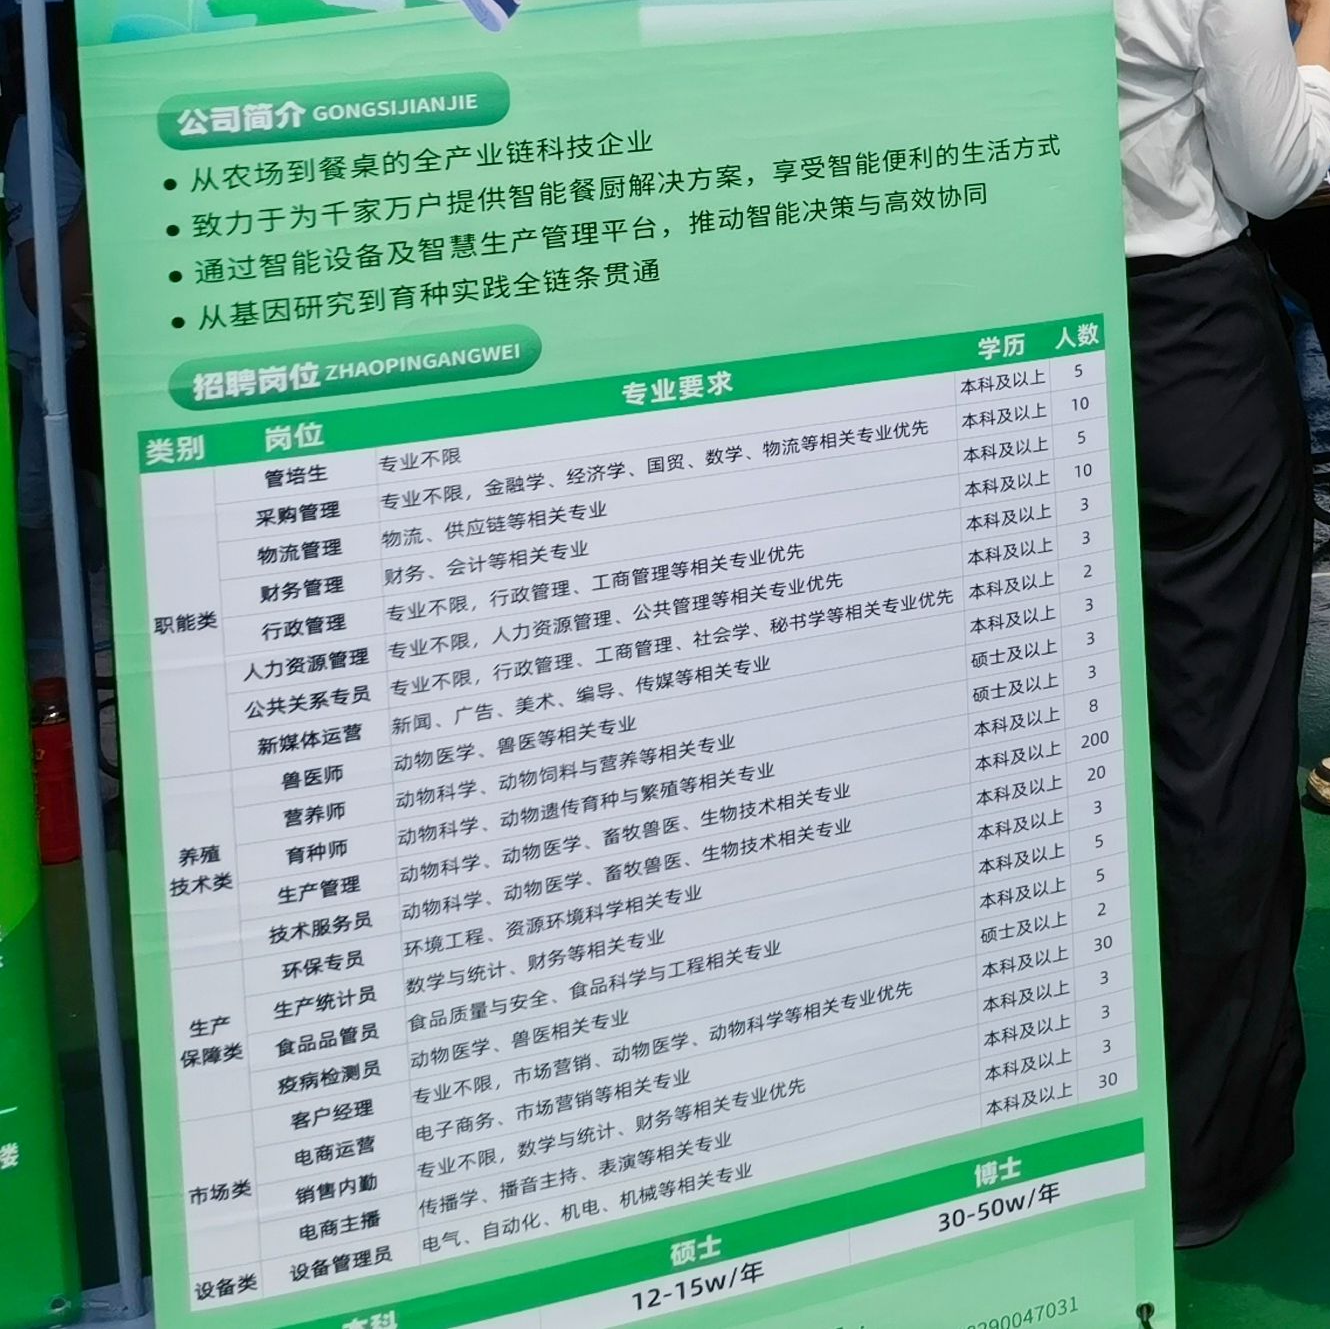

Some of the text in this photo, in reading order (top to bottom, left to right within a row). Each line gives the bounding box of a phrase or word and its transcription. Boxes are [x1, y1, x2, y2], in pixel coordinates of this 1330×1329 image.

[177, 93, 478, 137] 公司简介 GONGSIJIANJIE
[191, 129, 653, 192] 从农场到餐桌的全产业链科技企业
[192, 134, 1062, 238] 致力于为千家万户提供智能餐厨解决方案，享受智能便利的生活方式
[194, 182, 988, 284] 通过智能设备及智慧生产管理平台，推动智能决策与高效协同
[198, 258, 660, 331] 从基因研究到育种实践全链条贯通
[146, 323, 1099, 465] 类别 岗位 专业要求 学历 人数
[193, 344, 521, 401] 招聘岗位 ZHAOPINGANGWEI
[264, 363, 1083, 490] 管培生 专业不限 本科及以上 5
[255, 499, 342, 528] 采购管理
[961, 402, 1048, 430] 本科及以上
[1071, 396, 1090, 412] 10
[256, 430, 1086, 566] 物流管理 物流、供应链等相关专业 本科及以上 5
[259, 462, 1093, 604] 财务管理 财务、会计等相关专业 本科及以上 10
[153, 610, 219, 636] 职能类
[242, 530, 1091, 683] 人力资源管理 专业不限，人力资源管理、公共管理等相关专业优先 本科及以上 3
[261, 497, 1089, 642] 行政管理 专业不限，行政管理、工商管理等相关专业优先 本科及以上 3
[243, 684, 372, 720] 公共关系专员
[968, 570, 1055, 601] 本科及以上
[1083, 564, 1093, 579] 2
[257, 597, 1094, 757] 新媒体运营 新闻、广告、美术、编导、传媒等相关专业 本科及以上 3
[280, 630, 1096, 792] 兽医师 动物医学、兽医等相关专业 硕士及以上 3
[277, 729, 1110, 906] 生产管理 动物科学、动物医学、畜牧兽医、生物技术相关专业 本科及以上 200
[282, 664, 1097, 829] 营养师 动物科学、动物饲料与营养等相关专业 硕士及以上 3
[284, 698, 1099, 866] 育种师 动物科学、动物遗传育种与繁殖等相关专业 本科及以上 8
[169, 871, 234, 898] 技术类
[178, 843, 222, 868] 养殖
[267, 765, 1106, 946] 技术服务员 动物科学、动物医学、畜牧兽医、生物技术相关专业 本科及以上 20
[273, 833, 1104, 1020] 生产统计员 数学与统计、财务等相关专业 本科及以上 5
[281, 799, 1103, 980] 环保专员 环境工程、资源环境科学相关专业 本科及以上 3
[188, 1015, 231, 1039] 生产
[274, 867, 1105, 1059] 食品品管员 食品质量与安全、食品科学与工程相关专业 本科及以上 5
[277, 902, 1107, 1096] 疫病检测员 动物医学、兽医相关专业 硕士及以上 2
[289, 1097, 375, 1131] 客户经理
[981, 945, 1069, 979] 本科及以上
[1093, 935, 1113, 953] 30
[179, 1041, 244, 1069] 保障类
[294, 970, 1109, 1167] 电商运营 电子商务、市场营销等相关专业 本科及以上 3
[294, 1004, 1110, 1206] 销售内勤 专业不限，数学与统计、财务等相关专业优先 本科及以上 3
[188, 1178, 253, 1206] 市场类
[288, 1071, 1118, 1283] 设备管理员 电气、自动化、机电、机械等相关专业 本科及以上 30
[298, 1039, 1112, 1242] 电商主播 传播学、播音主持、表演等相关专业 本科及以上 3
[670, 1234, 722, 1267] 硕士
[975, 1156, 1022, 1187] 博士
[194, 1272, 259, 1301] 设备类
[632, 1181, 1061, 1311] 12-15w/年 30-50w/年
